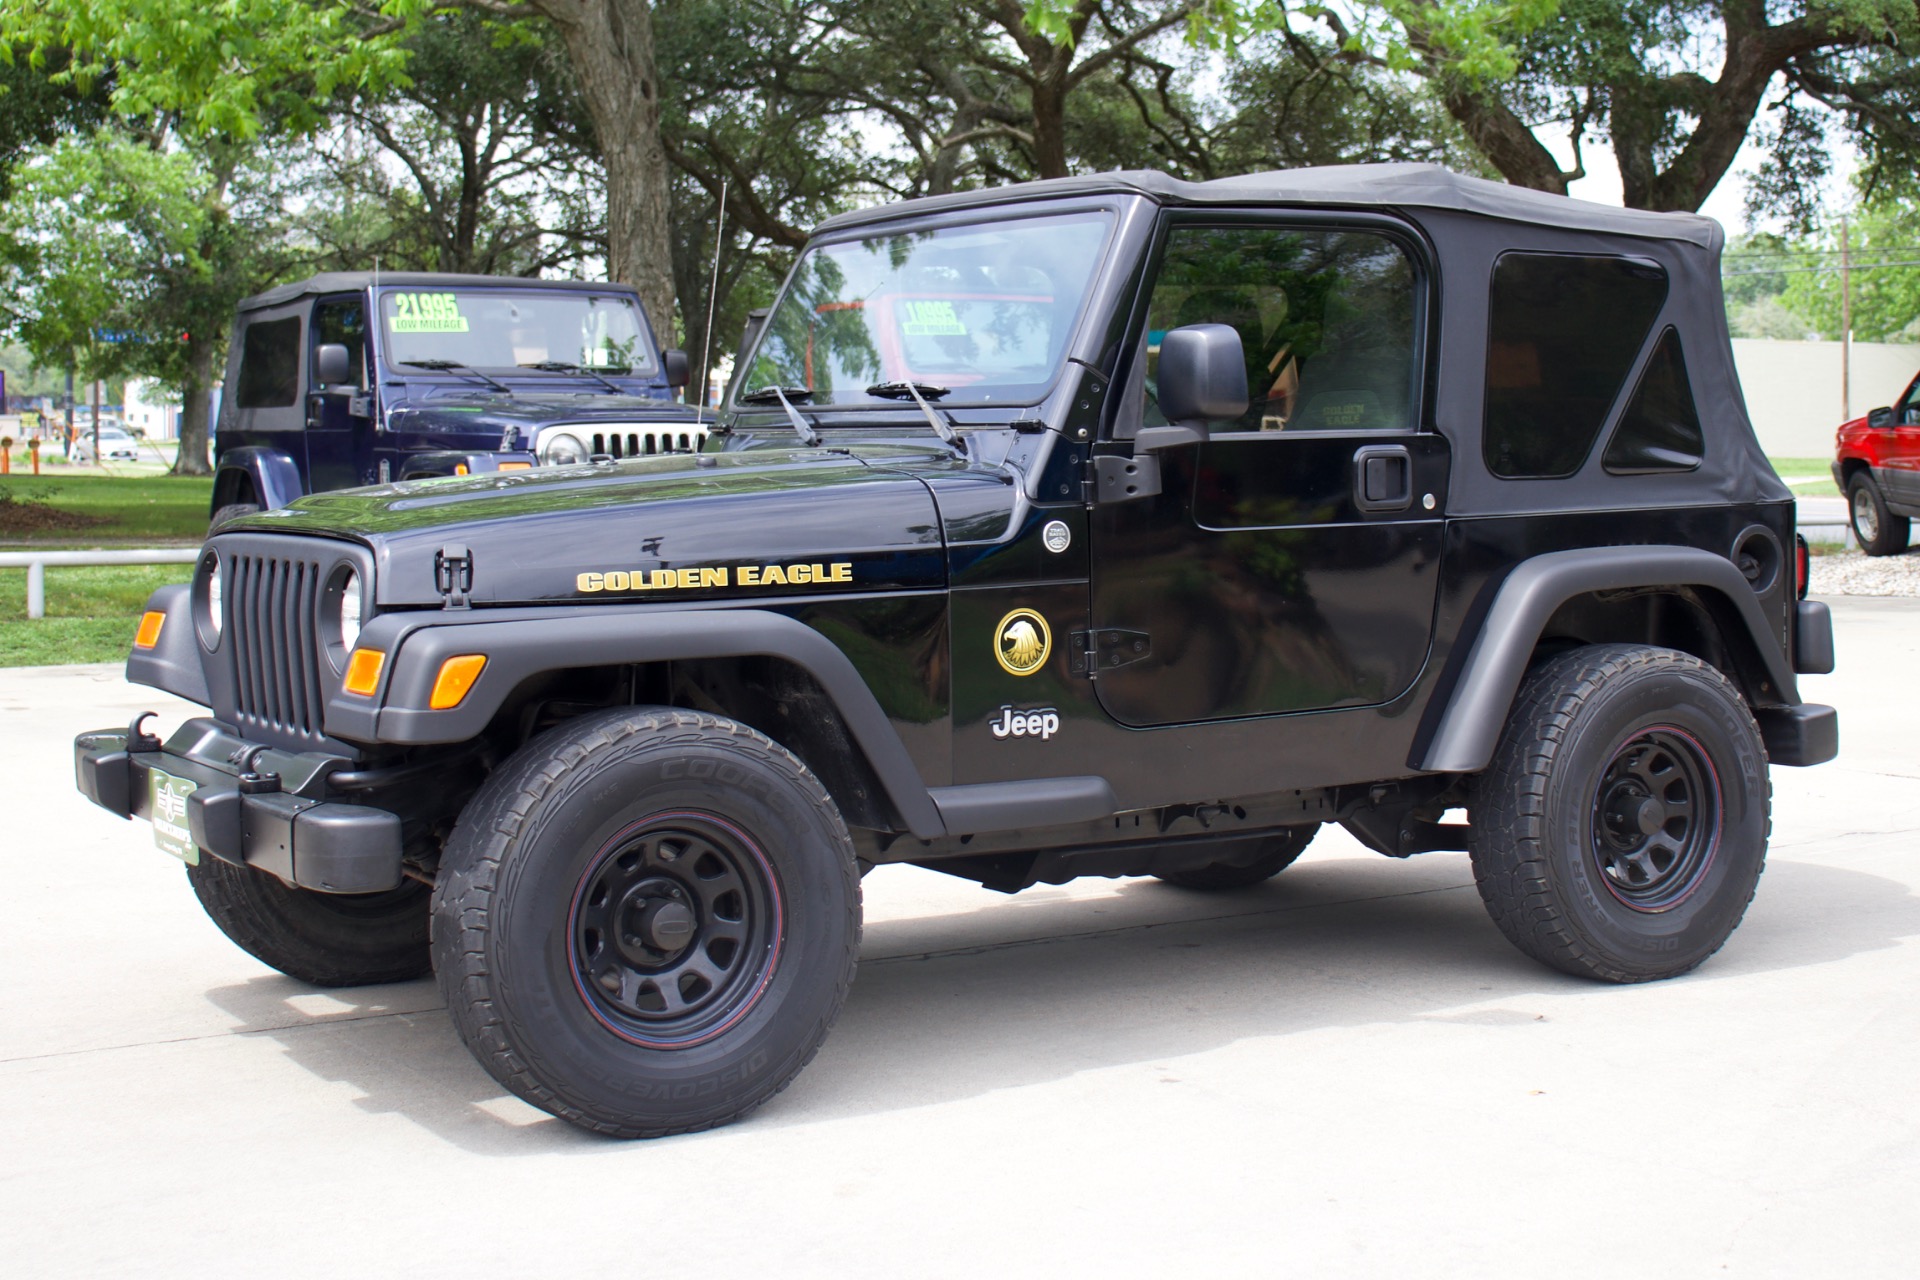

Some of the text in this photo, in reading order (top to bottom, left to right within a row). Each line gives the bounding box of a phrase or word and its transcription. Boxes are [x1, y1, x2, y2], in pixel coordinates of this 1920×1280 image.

[395, 292, 459, 319] 21995
[396, 319, 462, 329] LOW MILEAGE
[576, 562, 853, 592] GOLDEN EAGLE
[990, 707, 1060, 740] Jeep
